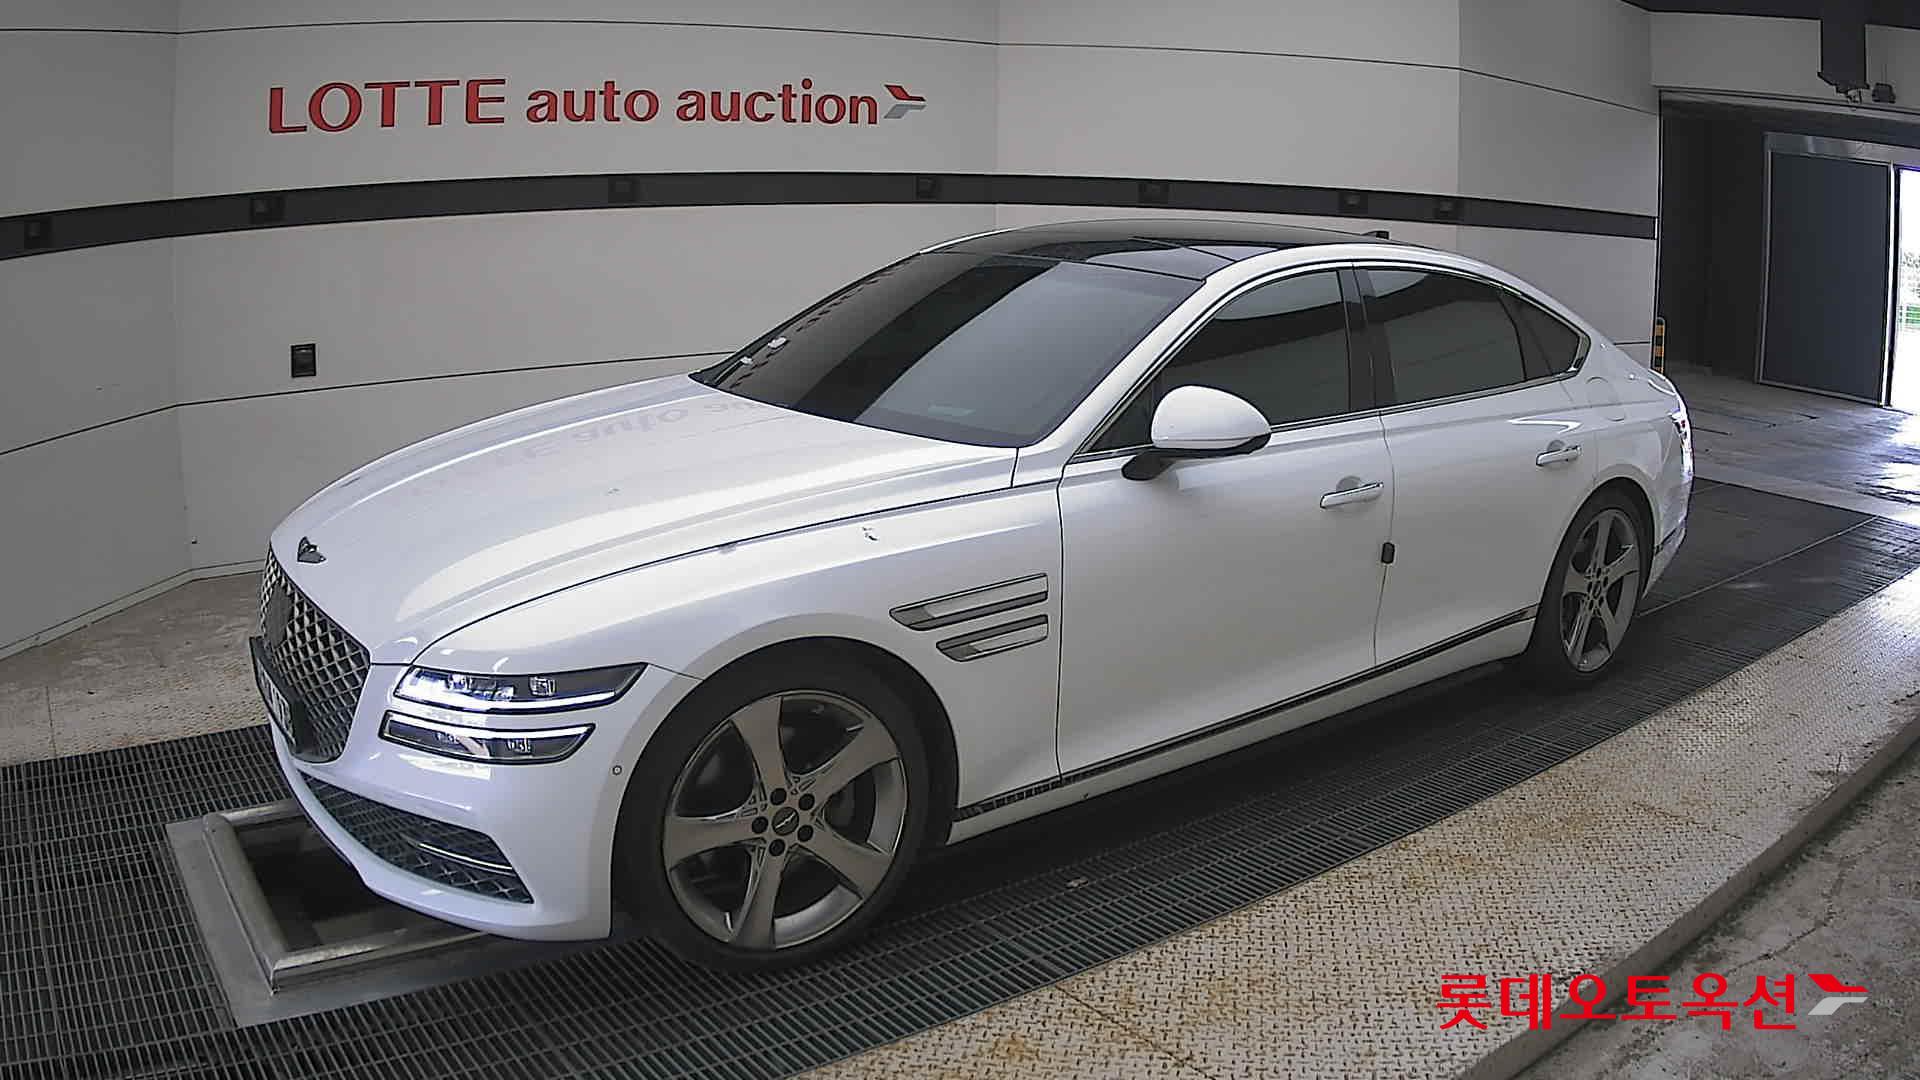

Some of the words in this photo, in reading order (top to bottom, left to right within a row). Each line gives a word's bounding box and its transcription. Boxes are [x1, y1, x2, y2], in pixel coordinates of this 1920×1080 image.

[268, 78, 505, 134] LOTTE
[526, 80, 660, 124] auto
[675, 78, 879, 125] auction
